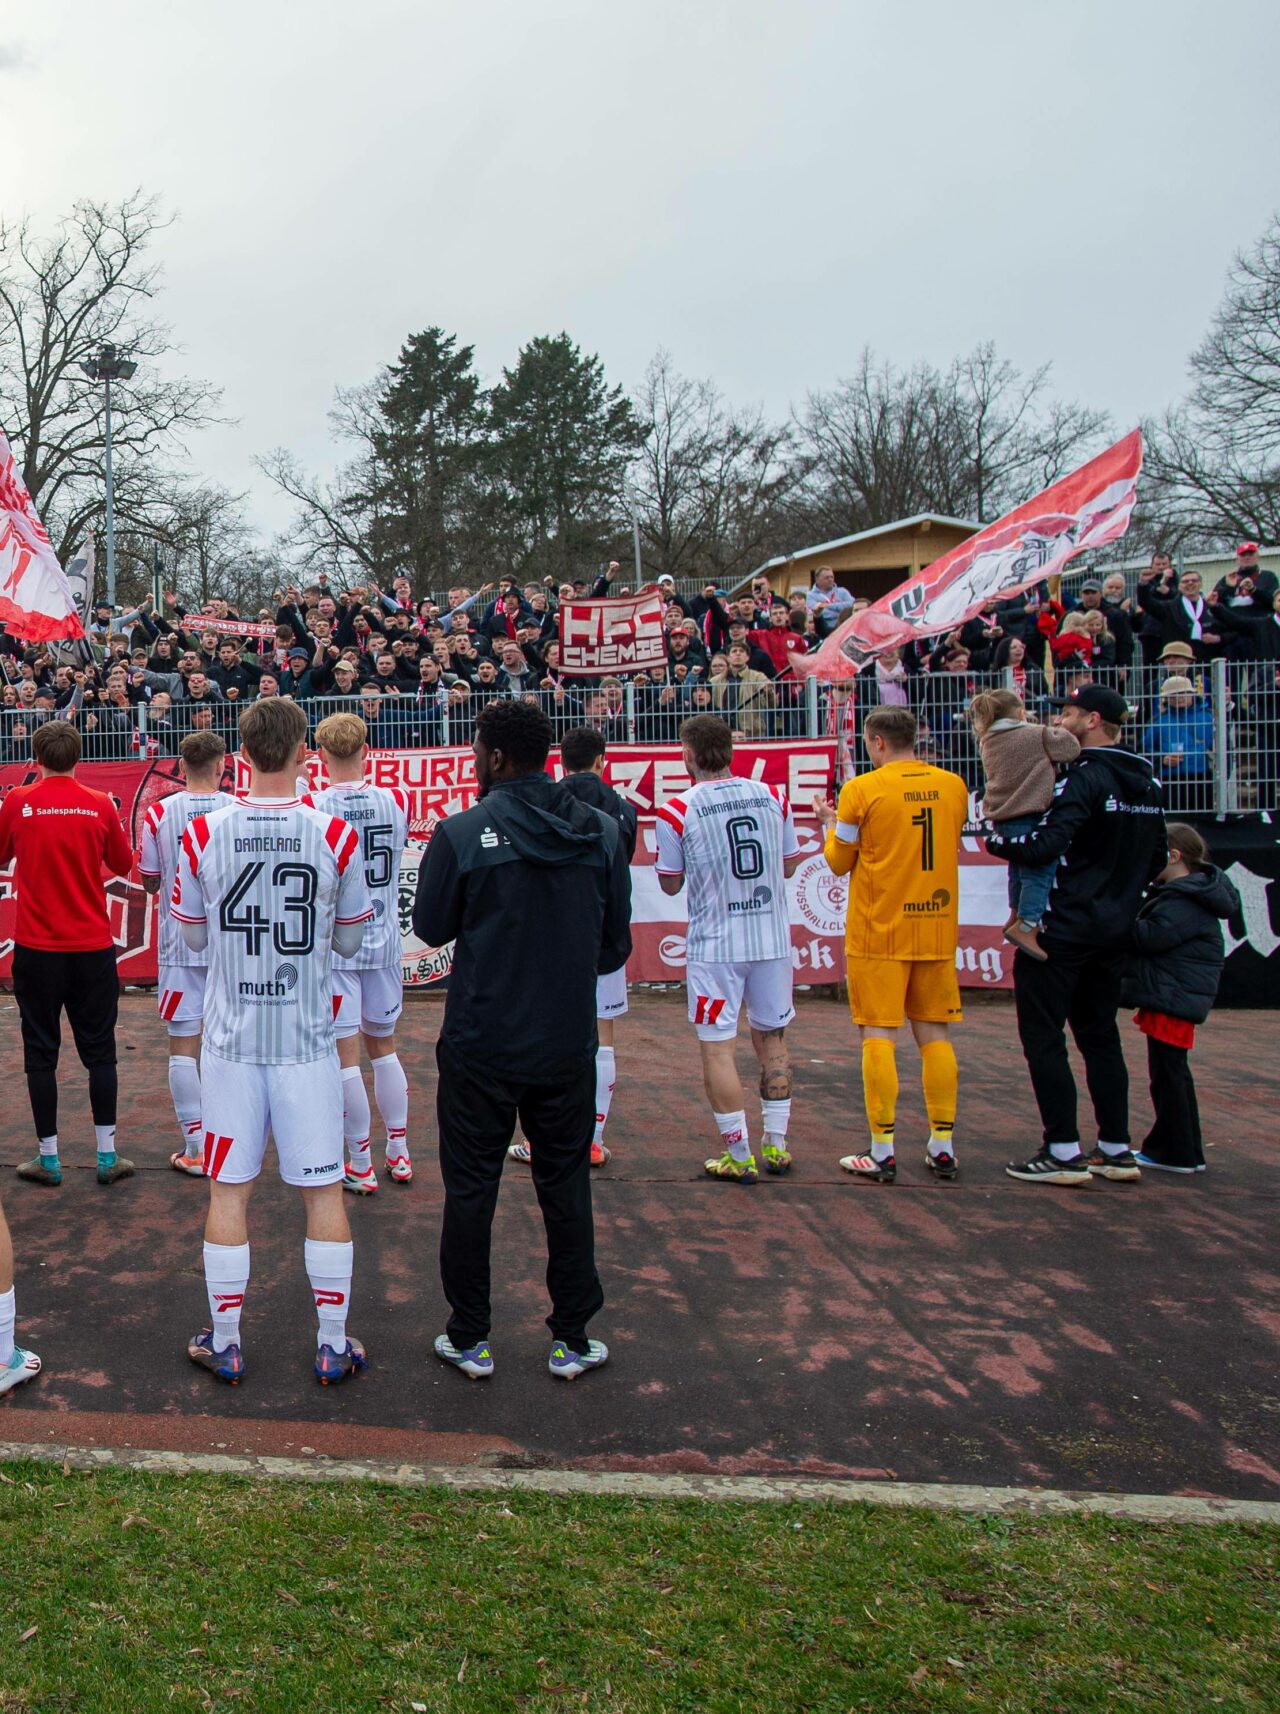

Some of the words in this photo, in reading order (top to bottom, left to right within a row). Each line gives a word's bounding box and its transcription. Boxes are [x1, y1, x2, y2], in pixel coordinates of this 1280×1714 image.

[564, 597, 662, 645] HFC
[563, 638, 664, 667] CHEMIE
[36, 806, 99, 819] Saalesparkasse
[343, 808, 376, 822] BECKER
[234, 836, 302, 853] DAMELANG
[726, 815, 764, 880] 6
[911, 807, 934, 871] 1
[220, 861, 318, 956] 43
[728, 896, 762, 912] muth
[903, 899, 940, 913] muth
[239, 980, 286, 997] muth
